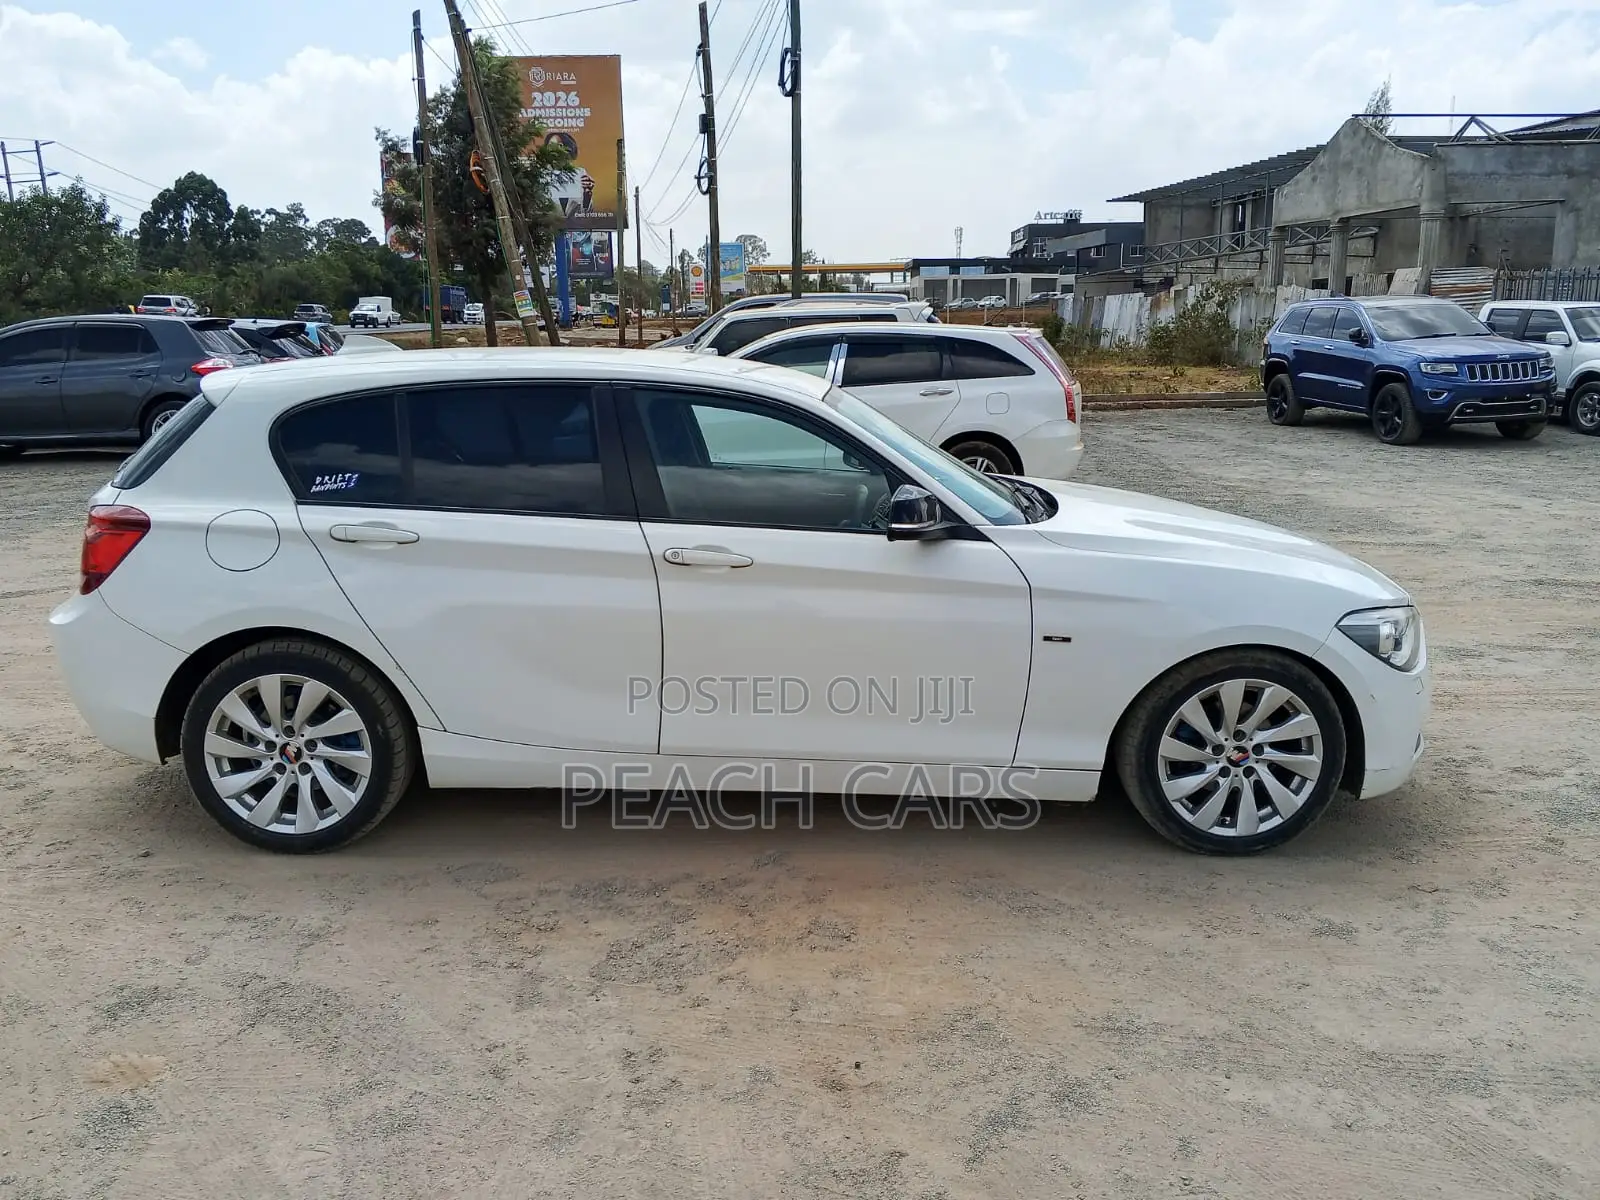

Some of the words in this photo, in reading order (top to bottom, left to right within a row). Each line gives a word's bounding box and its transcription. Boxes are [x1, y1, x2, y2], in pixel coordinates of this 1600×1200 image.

[546, 72, 576, 81] RIARA
[531, 91, 580, 107] 2026
[519, 107, 591, 118] ADMISSIONS
